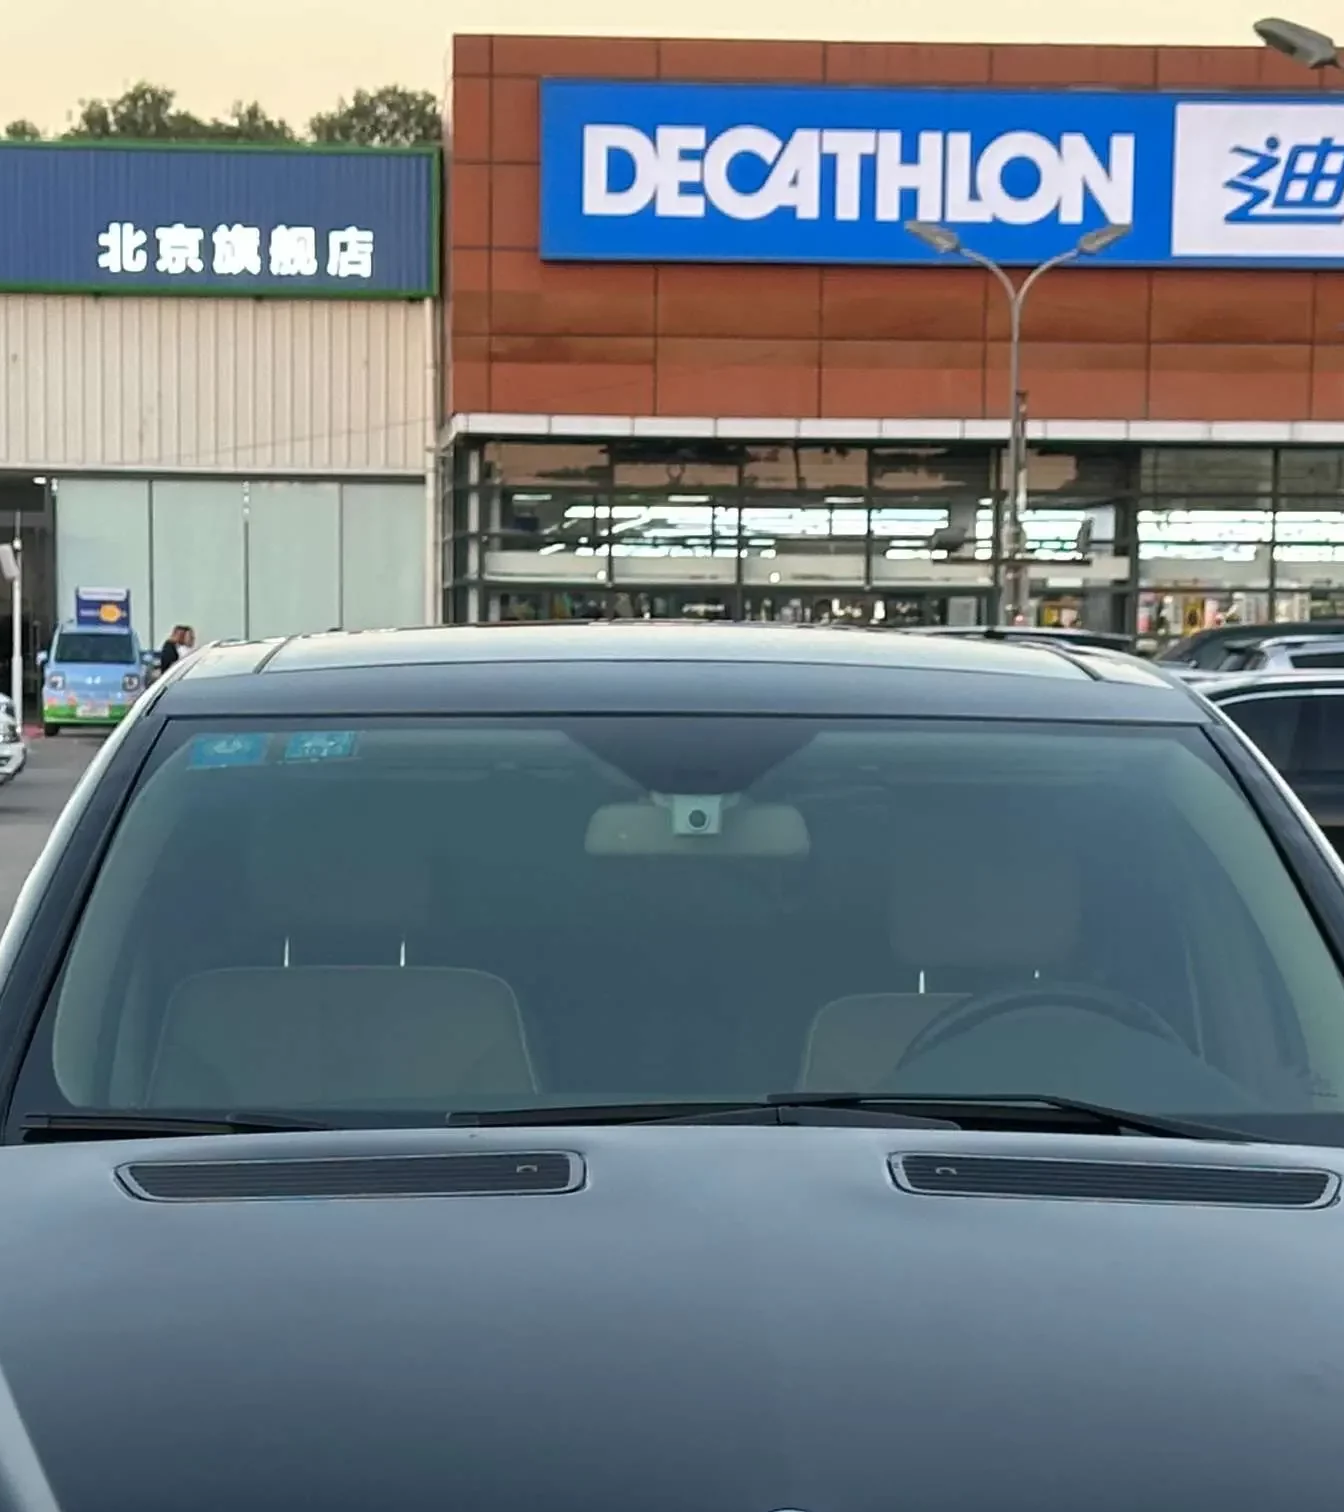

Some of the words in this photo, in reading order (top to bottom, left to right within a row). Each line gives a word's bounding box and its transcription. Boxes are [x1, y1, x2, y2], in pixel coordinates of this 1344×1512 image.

[582, 124, 1135, 225] DECATHLON
[98, 222, 374, 278] 北京旗舰店
